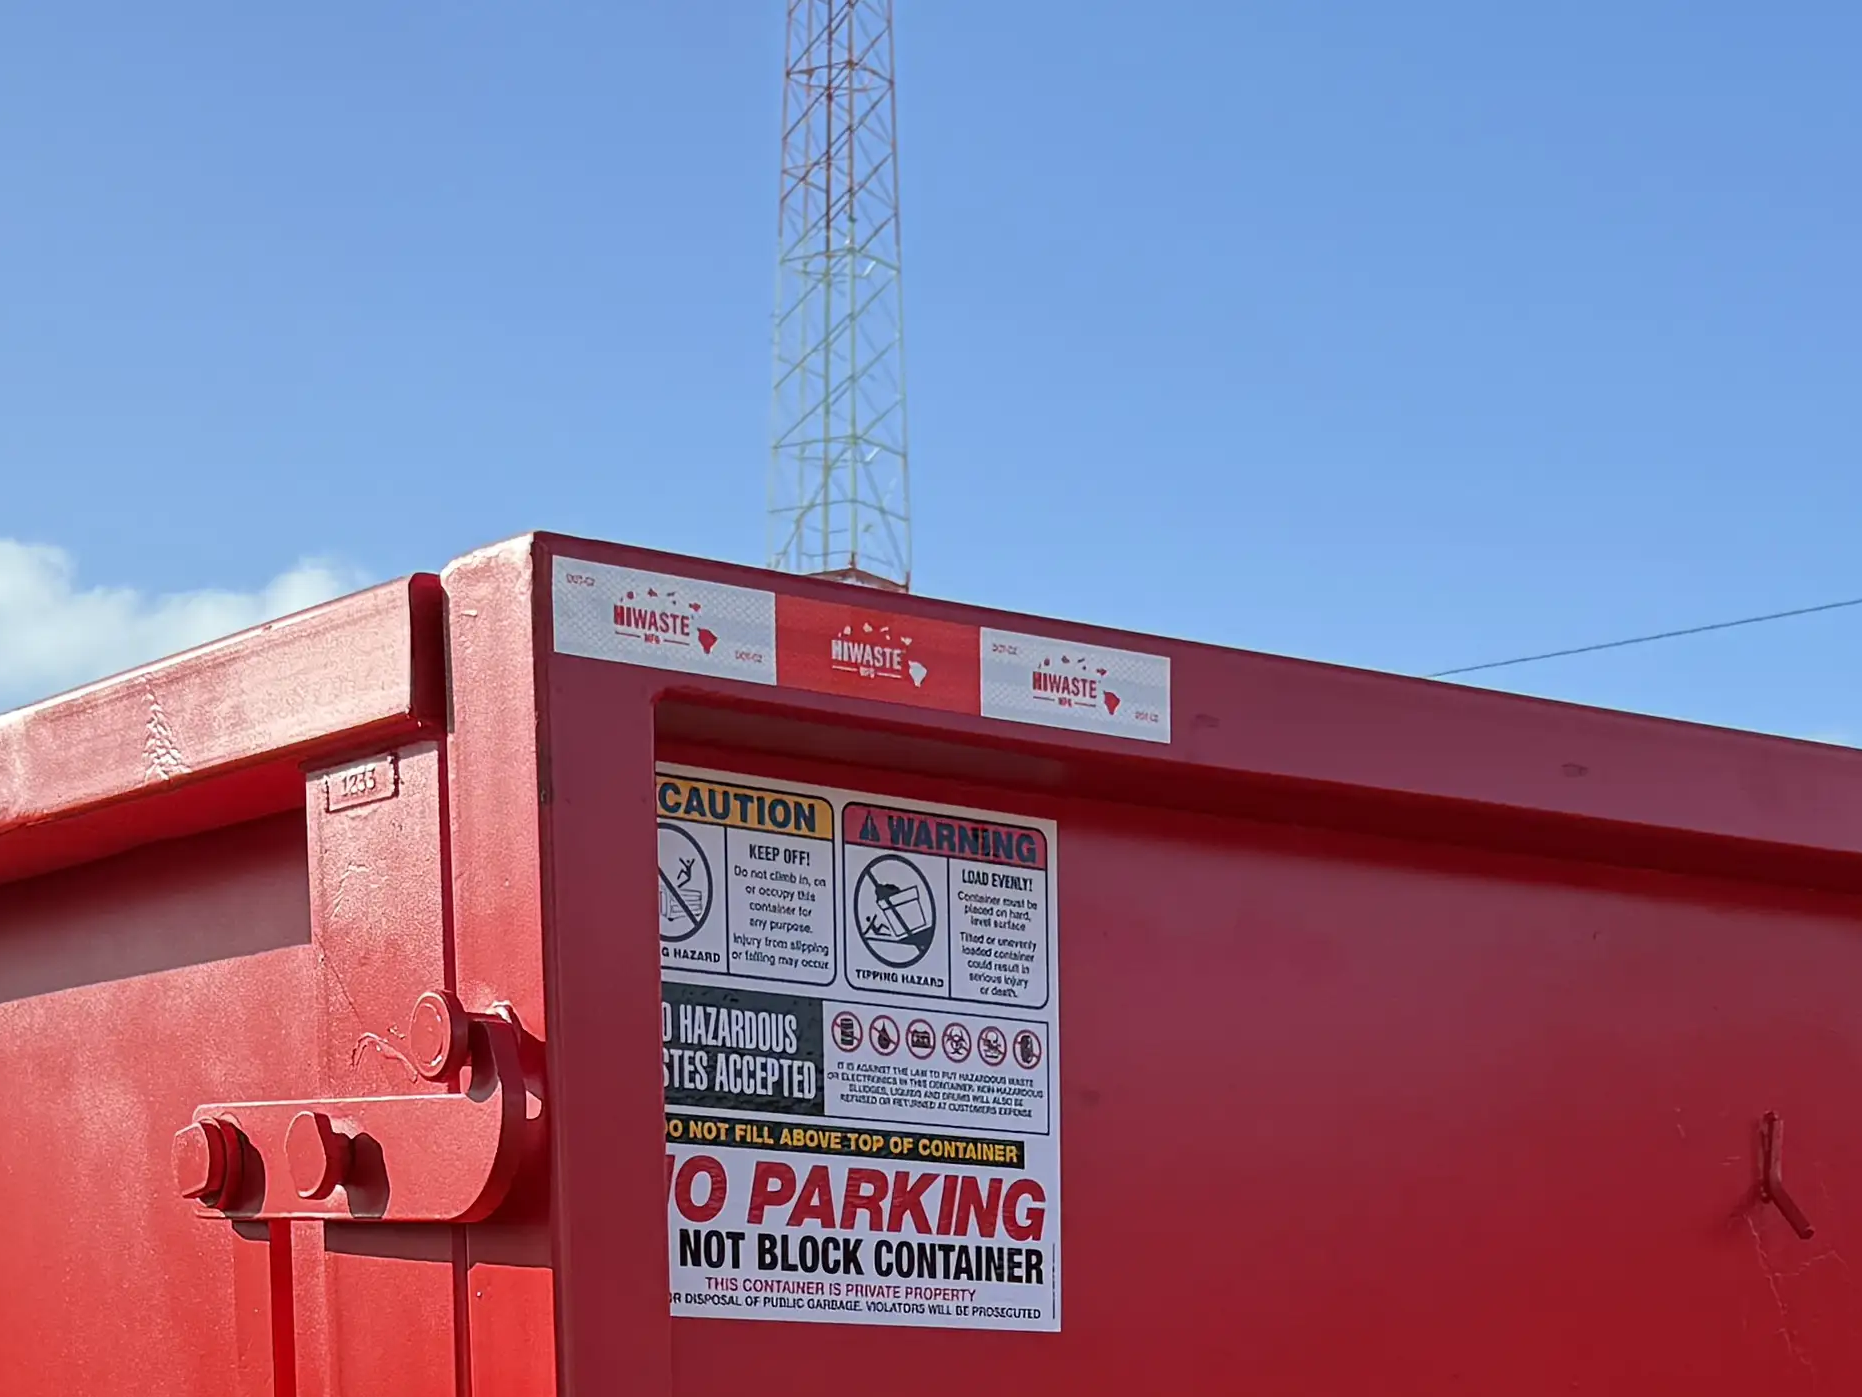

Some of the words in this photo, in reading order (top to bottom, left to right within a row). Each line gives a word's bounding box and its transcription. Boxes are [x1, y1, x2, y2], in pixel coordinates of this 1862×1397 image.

[613, 604, 690, 636] HIWASTE
[831, 639, 902, 670] HIWASTE
[1032, 671, 1097, 699] HIWASTE
[658, 782, 816, 833] CAUTION
[888, 815, 1037, 864] WARNING
[749, 844, 780, 861] KEEP
[783, 848, 810, 866] OFF!
[734, 865, 748, 877] Do
[751, 870, 768, 880] not
[770, 871, 796, 884] climb
[962, 869, 989, 886] LOAD
[992, 873, 1033, 892] EVENLY!
[745, 886, 756, 894] or
[759, 887, 795, 902] occupy
[797, 890, 816, 902] this
[958, 890, 1001, 906] Container
[1003, 898, 1025, 908] must
[1027, 900, 1037, 910] be
[749, 902, 796, 915] container
[798, 906, 812, 917] for
[964, 904, 993, 916] placed
[996, 909, 1007, 918] on
[749, 918, 767, 930] any
[770, 920, 813, 933] purpose.
[971, 916, 991, 928] level
[994, 920, 1026, 931] surface
[733, 933, 761, 948] Injury
[765, 937, 787, 949] from
[790, 940, 829, 956] slipping
[959, 931, 984, 944] Tilted
[986, 937, 995, 945] or
[998, 938, 1036, 952] unevenly
[662, 946, 670, 957] G
[674, 948, 721, 963] HAZARD
[731, 951, 743, 960] or
[745, 950, 775, 966] falling
[778, 956, 799, 968] may
[962, 945, 992, 957] loaded
[994, 951, 1035, 962] container
[967, 960, 992, 970] could
[994, 963, 1019, 973] result
[1021, 964, 1030, 974] in
[856, 969, 898, 983] TIPPING
[901, 974, 944, 988] HAZARD
[969, 973, 1002, 984] serious
[1004, 975, 1028, 989] injury
[980, 987, 989, 995] or
[679, 1004, 797, 1054] HAZARDOUS
[715, 1053, 816, 1099] ACCEPTED
[857, 1063, 891, 1074] AGAINST
[893, 1066, 908, 1076] THE
[910, 1069, 927, 1078] LAW
[930, 1070, 940, 1079] TO
[942, 1071, 957, 1080] PUT
[959, 1073, 1006, 1085] HAZARDOUS
[1008, 1077, 1033, 1088] WASTE
[910, 1078, 927, 1089] THIS
[997, 1087, 1044, 1099] HAZARDOUS
[924, 1090, 940, 1100] AND
[972, 1094, 990, 1104] WILL
[992, 1096, 1013, 1106] ALSO
[879, 1097, 890, 1105] OR
[937, 1101, 947, 1110] AT
[664, 1119, 683, 1138] O
[689, 1120, 730, 1141] NOT
[734, 1123, 774, 1145] FILL
[779, 1128, 842, 1151] ABOVE
[847, 1133, 885, 1153] TOP
[889, 1136, 914, 1154] OF
[918, 1138, 1018, 1164] CONTAINER
[746, 1160, 1046, 1242] PARKING
[679, 1228, 746, 1269] NOT
[757, 1233, 864, 1275] BLOCK
[874, 1239, 1044, 1285] CONTAINER
[705, 1276, 738, 1292] THIS
[742, 1278, 825, 1296] CONTAINER
[829, 1283, 841, 1296] IS
[845, 1283, 901, 1299] PRIVATE
[905, 1287, 976, 1302] PROPERTY
[685, 1293, 742, 1307] DISPOSAL
[745, 1296, 760, 1307] OF
[763, 1296, 804, 1309] PUBLIC
[866, 1300, 926, 1314] VIOLATORS
[928, 1303, 951, 1316] WILL
[955, 1305, 970, 1317] BE
[972, 1305, 1041, 1320] PROSECUTED
